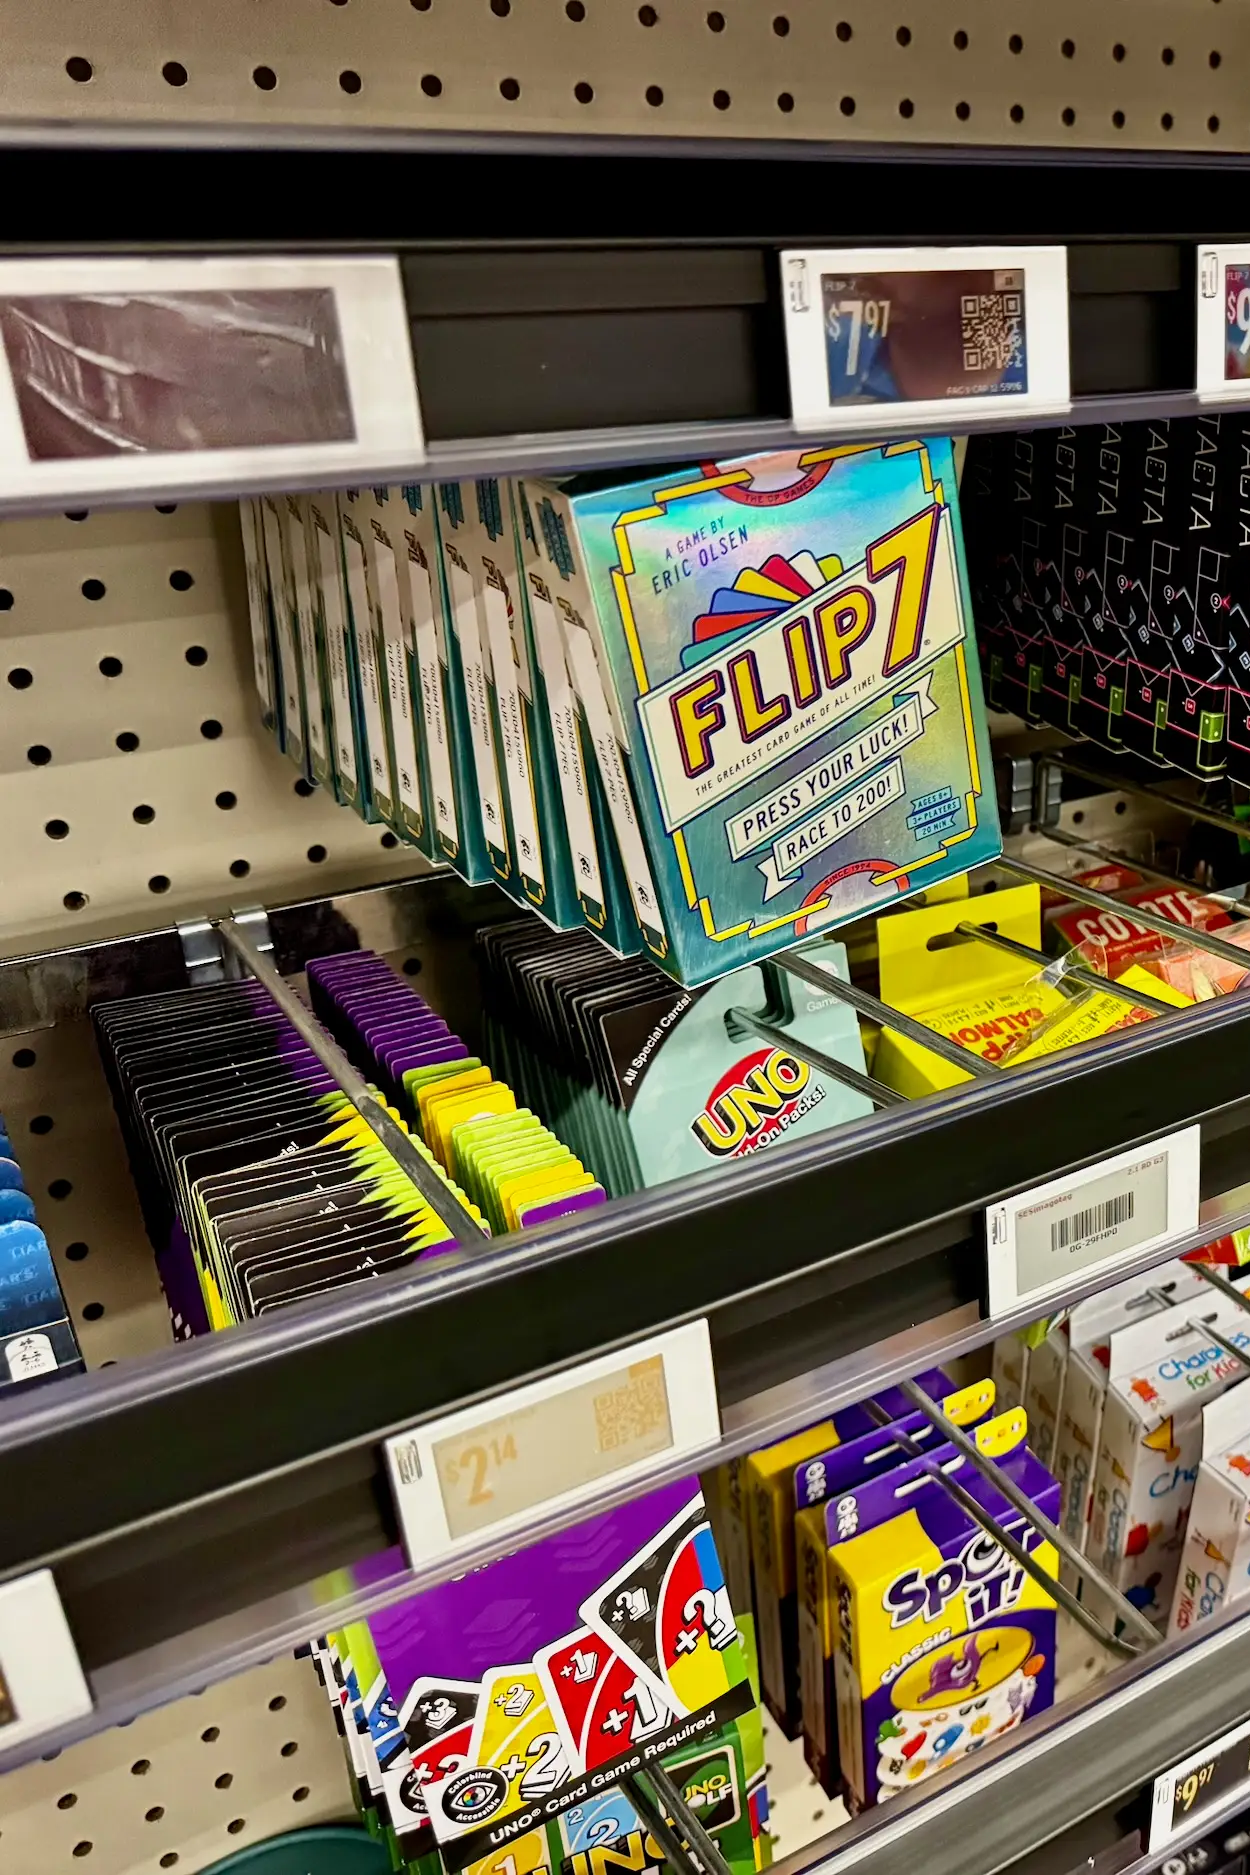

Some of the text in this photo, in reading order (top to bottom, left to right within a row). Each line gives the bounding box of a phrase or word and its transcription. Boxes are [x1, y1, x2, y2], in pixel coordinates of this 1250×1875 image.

[744, 493, 765, 504] THE
[783, 478, 815, 502] GAMES
[1096, 422, 1122, 516] ACTA
[652, 525, 750, 595] ERIC OLSEN
[664, 516, 725, 561] A GAME BY
[669, 502, 942, 780] FLIP 7
[696, 674, 877, 797] THE GREATEST CARD GAME OF ALL TIME!
[743, 713, 909, 841] PRESS YOUR LUCK!
[916, 794, 937, 810] AGES
[786, 775, 894, 861] RACE TO 200!
[921, 824, 932, 836] 20
[923, 799, 958, 823] PLAYERS
[824, 868, 849, 886] SINCE
[622, 993, 692, 1087] All Special Cards!
[695, 1049, 812, 1155] UNO
[781, 1083, 828, 1133] Packs!
[1186, 1367, 1214, 1392] for
[880, 1626, 953, 1686] CLASSIC
[447, 1770, 493, 1796] Colorblind
[545, 1783, 588, 1813] Card
[590, 1754, 642, 1788] Game
[641, 1708, 719, 1761] Required
[455, 1796, 507, 1824] Accessible
